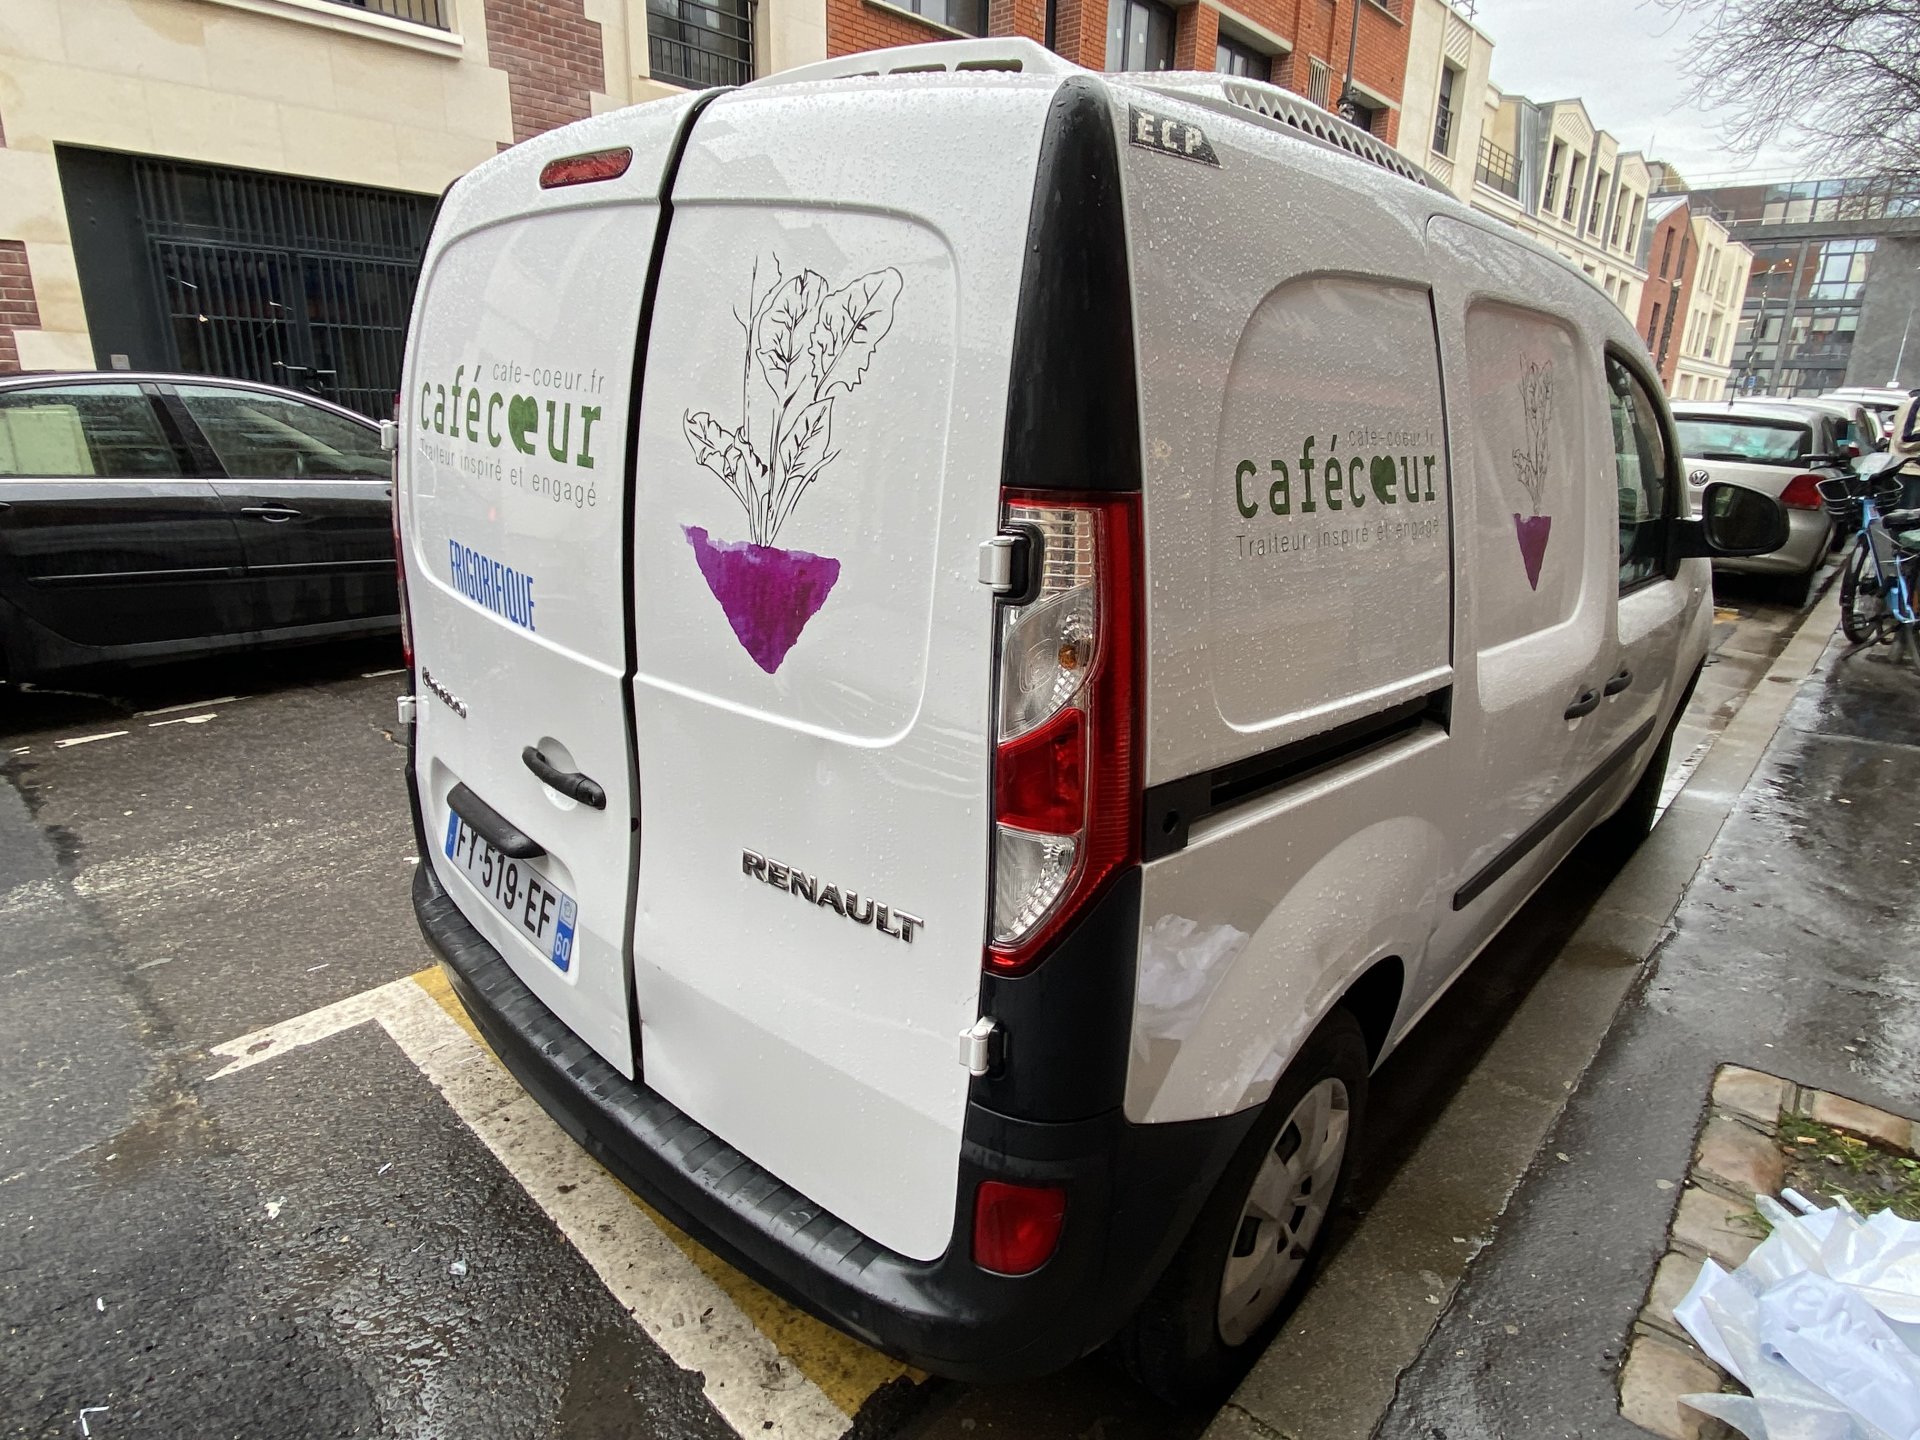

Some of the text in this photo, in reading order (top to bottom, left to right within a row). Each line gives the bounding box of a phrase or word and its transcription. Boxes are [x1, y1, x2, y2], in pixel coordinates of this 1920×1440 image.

[1137, 111, 1203, 155] ECP
[492, 360, 606, 395] cafe-coeur.fr
[420, 438, 597, 509] Traiteur inspiré et engagé
[1236, 534, 1308, 557] Traiteur
[448, 538, 536, 632] FRIGORIFIQUE
[456, 822, 556, 939] FY-519-EF
[742, 847, 925, 944] RENAULT
[554, 932, 570, 962] 60
